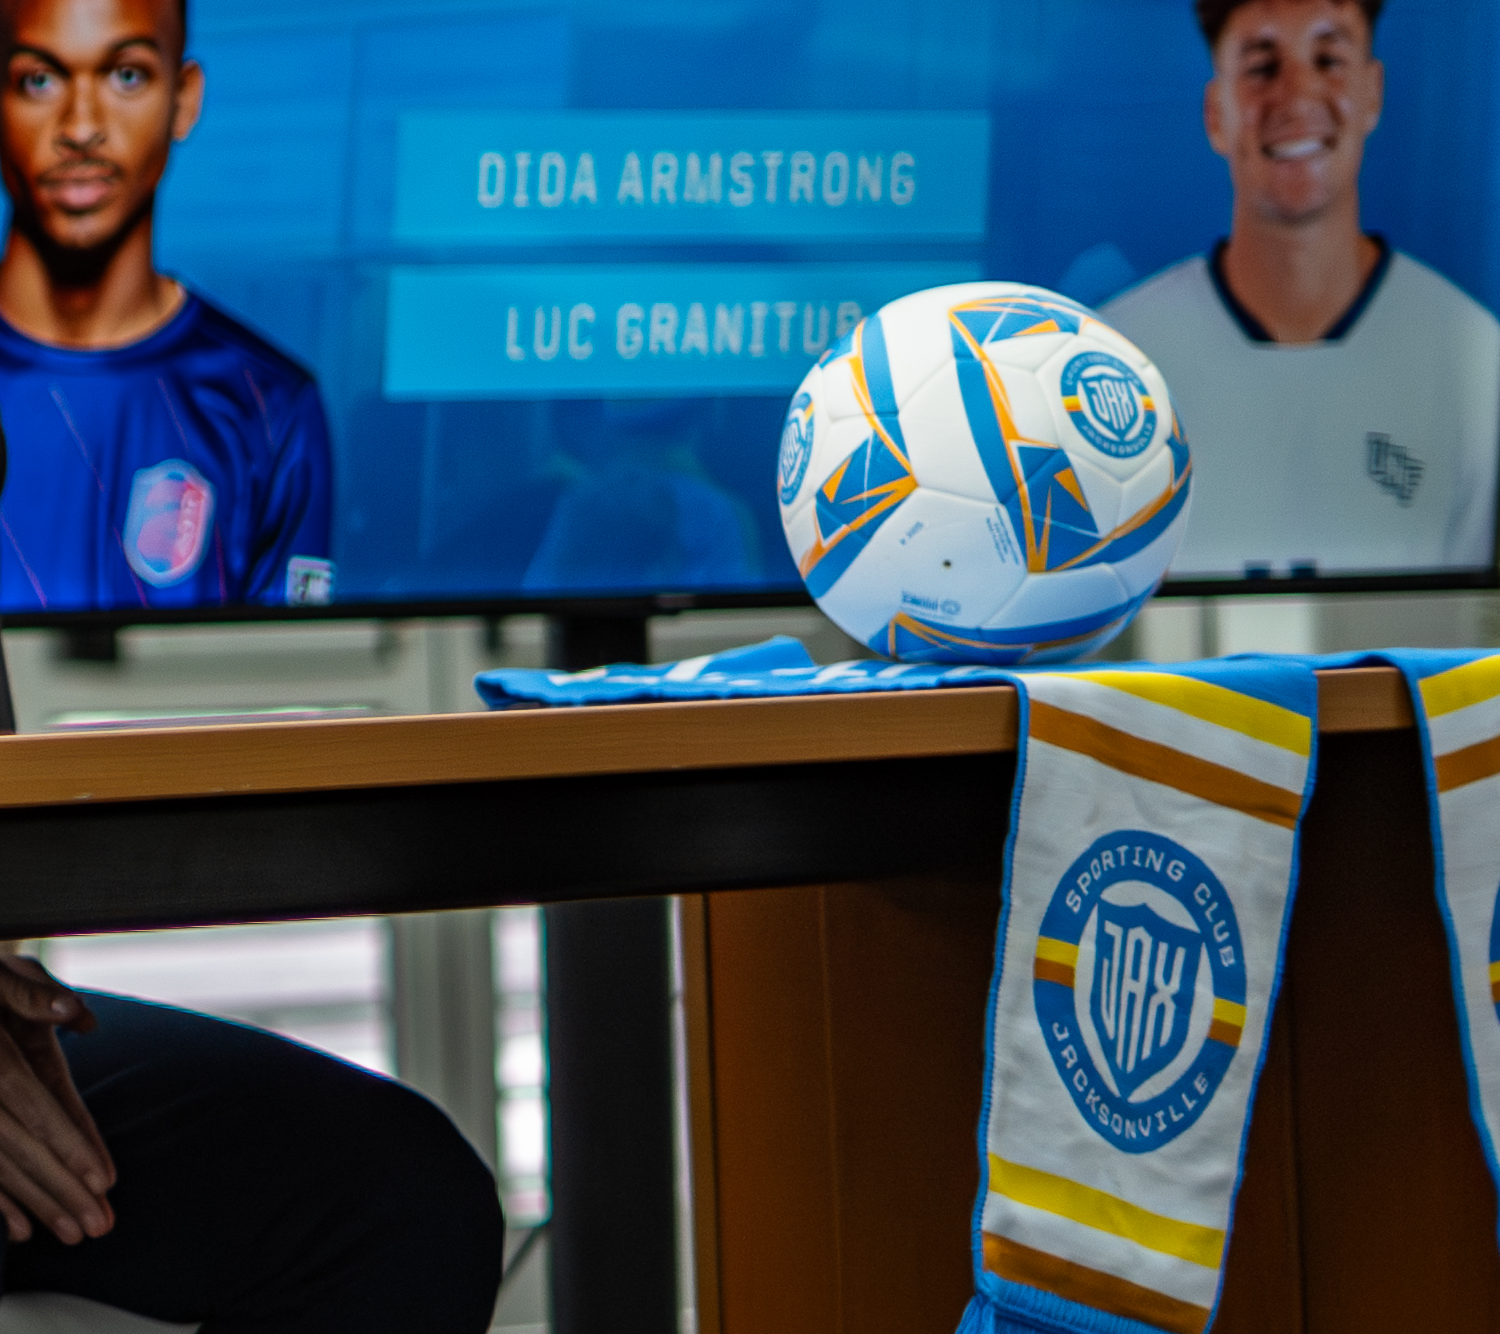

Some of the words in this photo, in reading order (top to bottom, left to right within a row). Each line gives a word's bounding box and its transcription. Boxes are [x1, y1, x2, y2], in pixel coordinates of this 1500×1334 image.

[616, 151, 917, 208] ARMSTRONG
[506, 304, 595, 361] LUC
[1086, 379, 1135, 430] JAX
[1065, 844, 1187, 915] SPORTING
[1192, 882, 1237, 968] CLUB
[1100, 919, 1187, 1075] JAX
[1052, 1021, 1210, 1140] JACKSONVILLE
